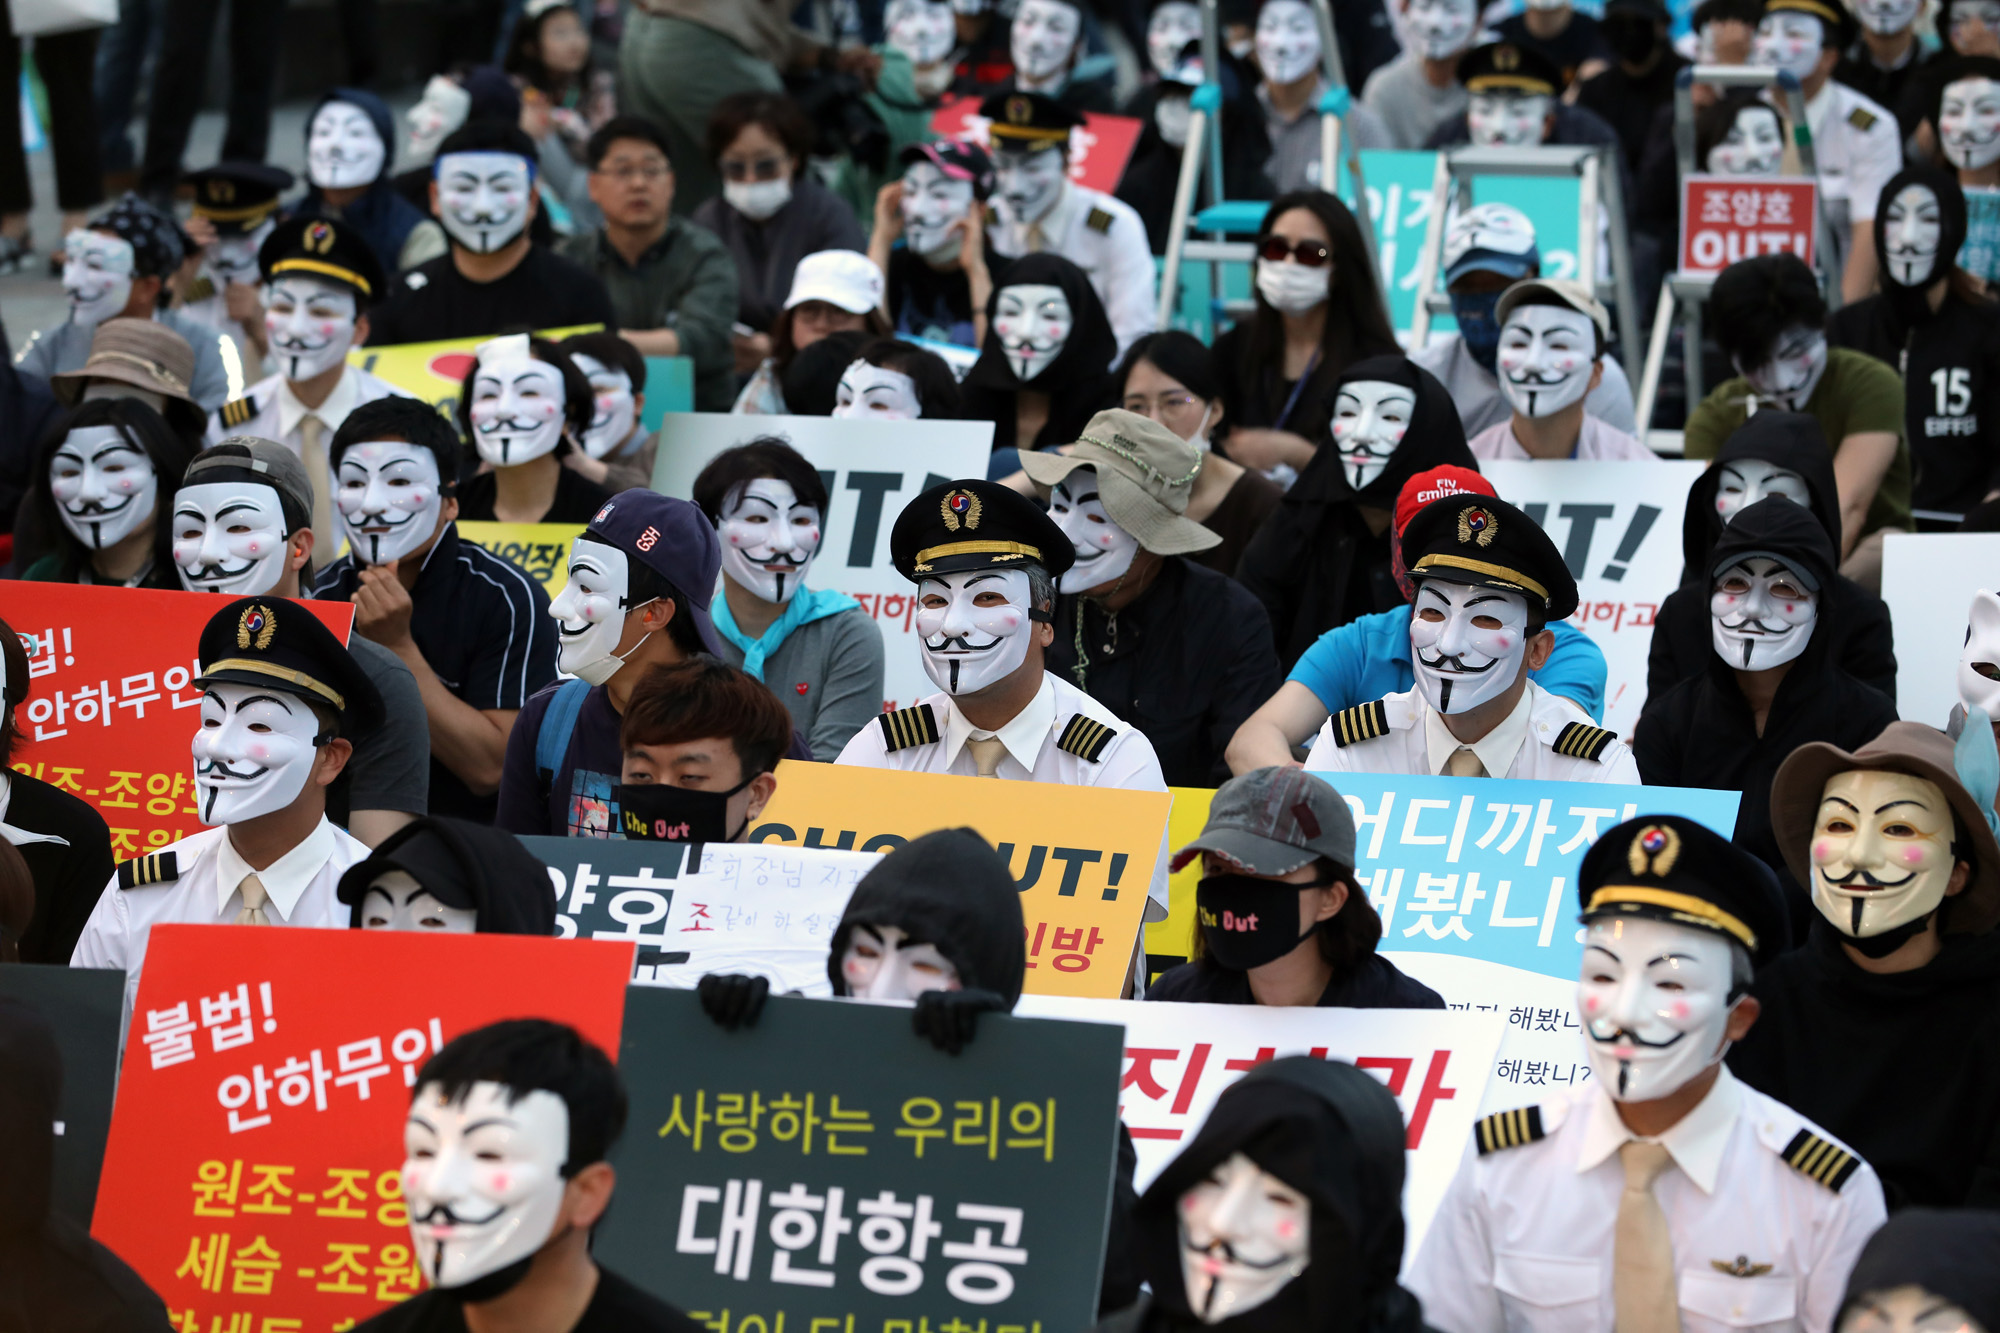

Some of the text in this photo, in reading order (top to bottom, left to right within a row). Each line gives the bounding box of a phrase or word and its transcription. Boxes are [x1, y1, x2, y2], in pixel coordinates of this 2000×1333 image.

[1701, 189, 1794, 227] 조양호
[1930, 366, 1972, 417] 15
[1436, 478, 1457, 489] Fly
[636, 525, 661, 552] GSH
[23, 626, 75, 679] 법!
[27, 658, 202, 742] 안하무인
[10, 762, 198, 816] 조-조양
[655, 819, 691, 840] Out
[996, 841, 1129, 902] UT!
[547, 862, 677, 947] 양호
[1222, 909, 1259, 932] Out
[1353, 867, 1589, 948] 해봤니
[142, 981, 278, 1070] 불법!
[217, 1017, 444, 1134] 안하무인
[658, 1089, 1056, 1163] 사랑하는 우리의
[175, 1233, 423, 1303] 세습 -조원
[676, 1179, 1028, 1305] 대한항공
